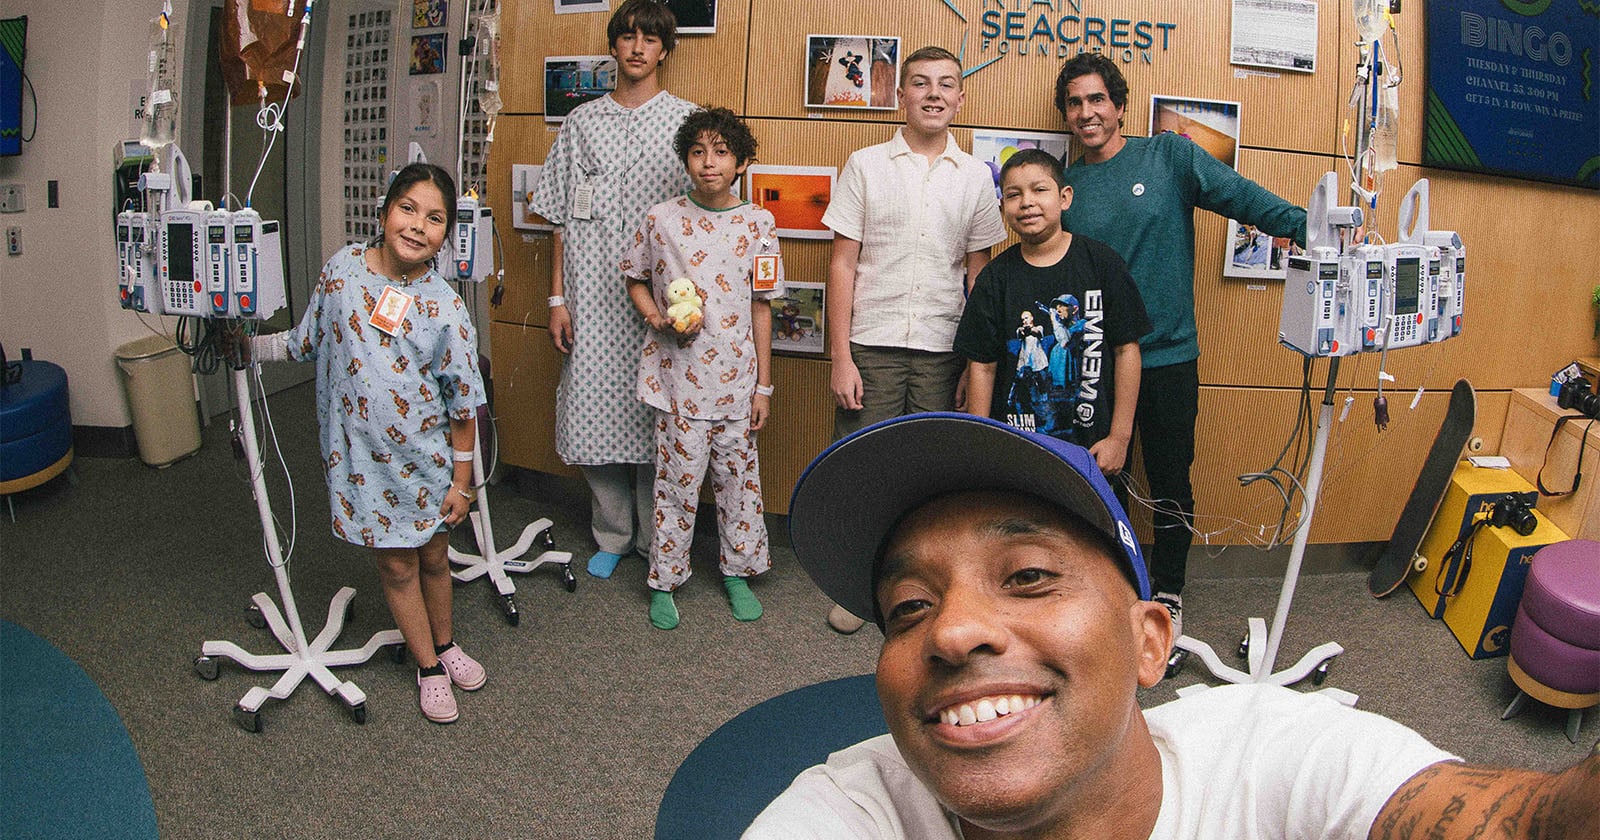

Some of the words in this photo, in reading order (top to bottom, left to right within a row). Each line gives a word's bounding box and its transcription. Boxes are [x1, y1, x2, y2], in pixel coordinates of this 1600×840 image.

[981, 10, 1177, 50] SEACREST
[1460, 11, 1572, 66] BINGO
[1466, 56, 1510, 74] TUESDAY
[1511, 65, 1518, 76] &
[1520, 67, 1568, 86] THURSDAY
[1465, 75, 1511, 92] CHANNEL
[1546, 90, 1559, 102] PM
[1465, 92, 1484, 104] GET
[1079, 289, 1104, 400] EMINEM
[1006, 413, 1035, 427] SLIM
